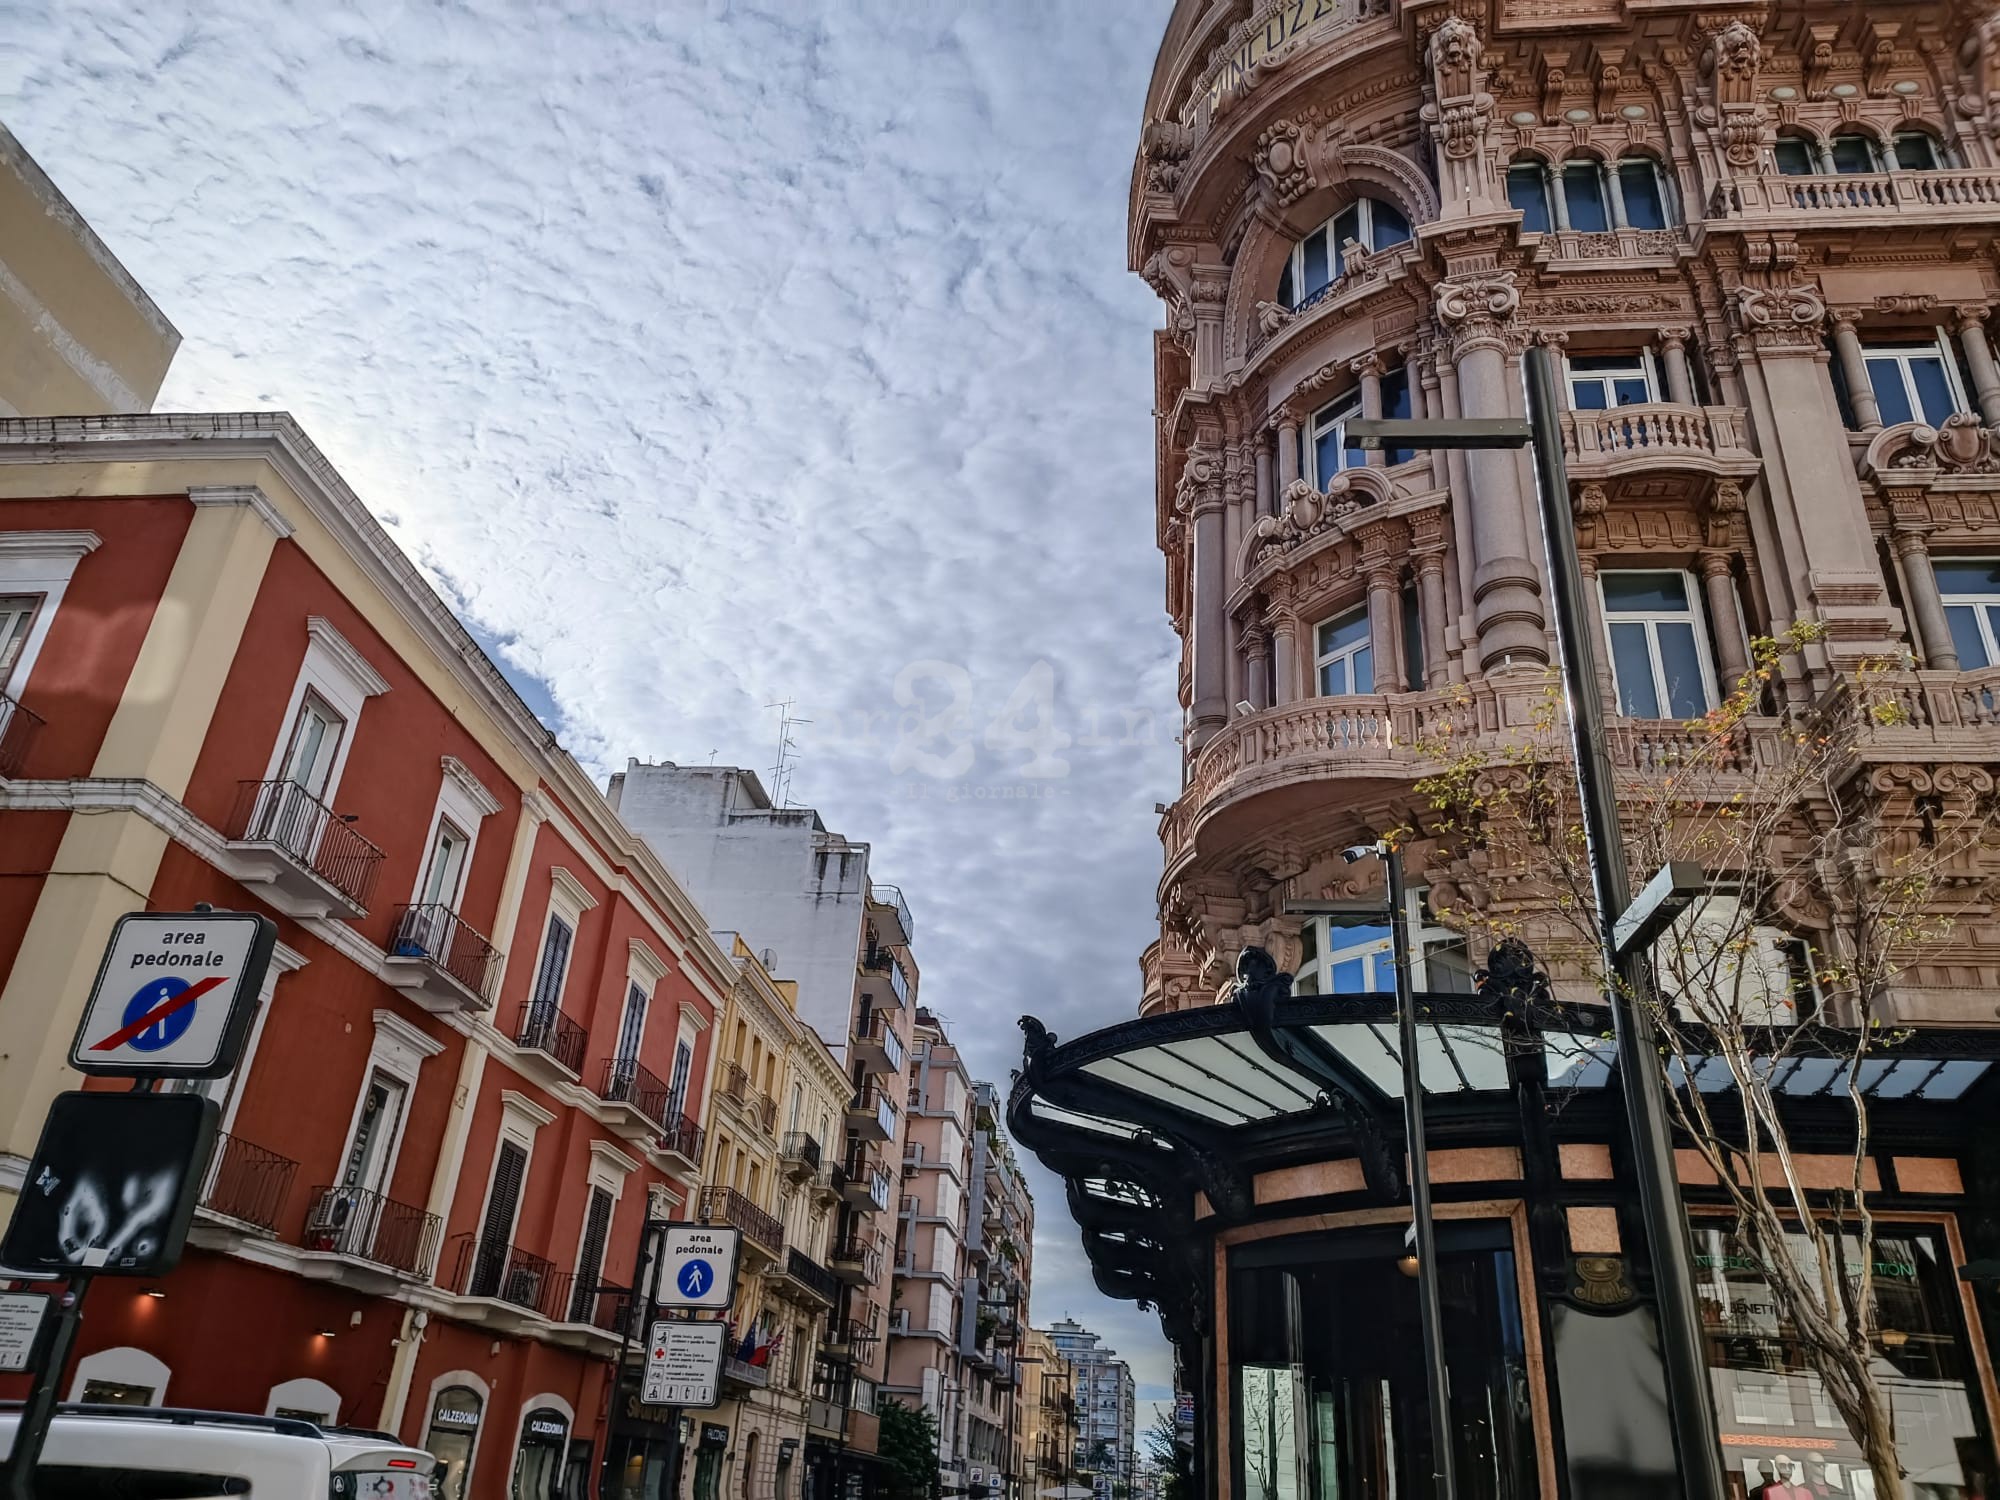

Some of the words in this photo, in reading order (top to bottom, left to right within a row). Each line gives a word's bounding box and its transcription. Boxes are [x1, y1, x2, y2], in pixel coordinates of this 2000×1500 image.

[1208, 0, 1343, 103] MINCUZZ
[162, 929, 206, 946] area
[130, 950, 224, 969] pedonale
[689, 1234, 712, 1243] area
[675, 1244, 724, 1255] pedonale
[1730, 1303, 1774, 1316] BENETT
[438, 1408, 479, 1425] CALZEDONIA
[531, 1420, 564, 1434] CALZEDONIA
